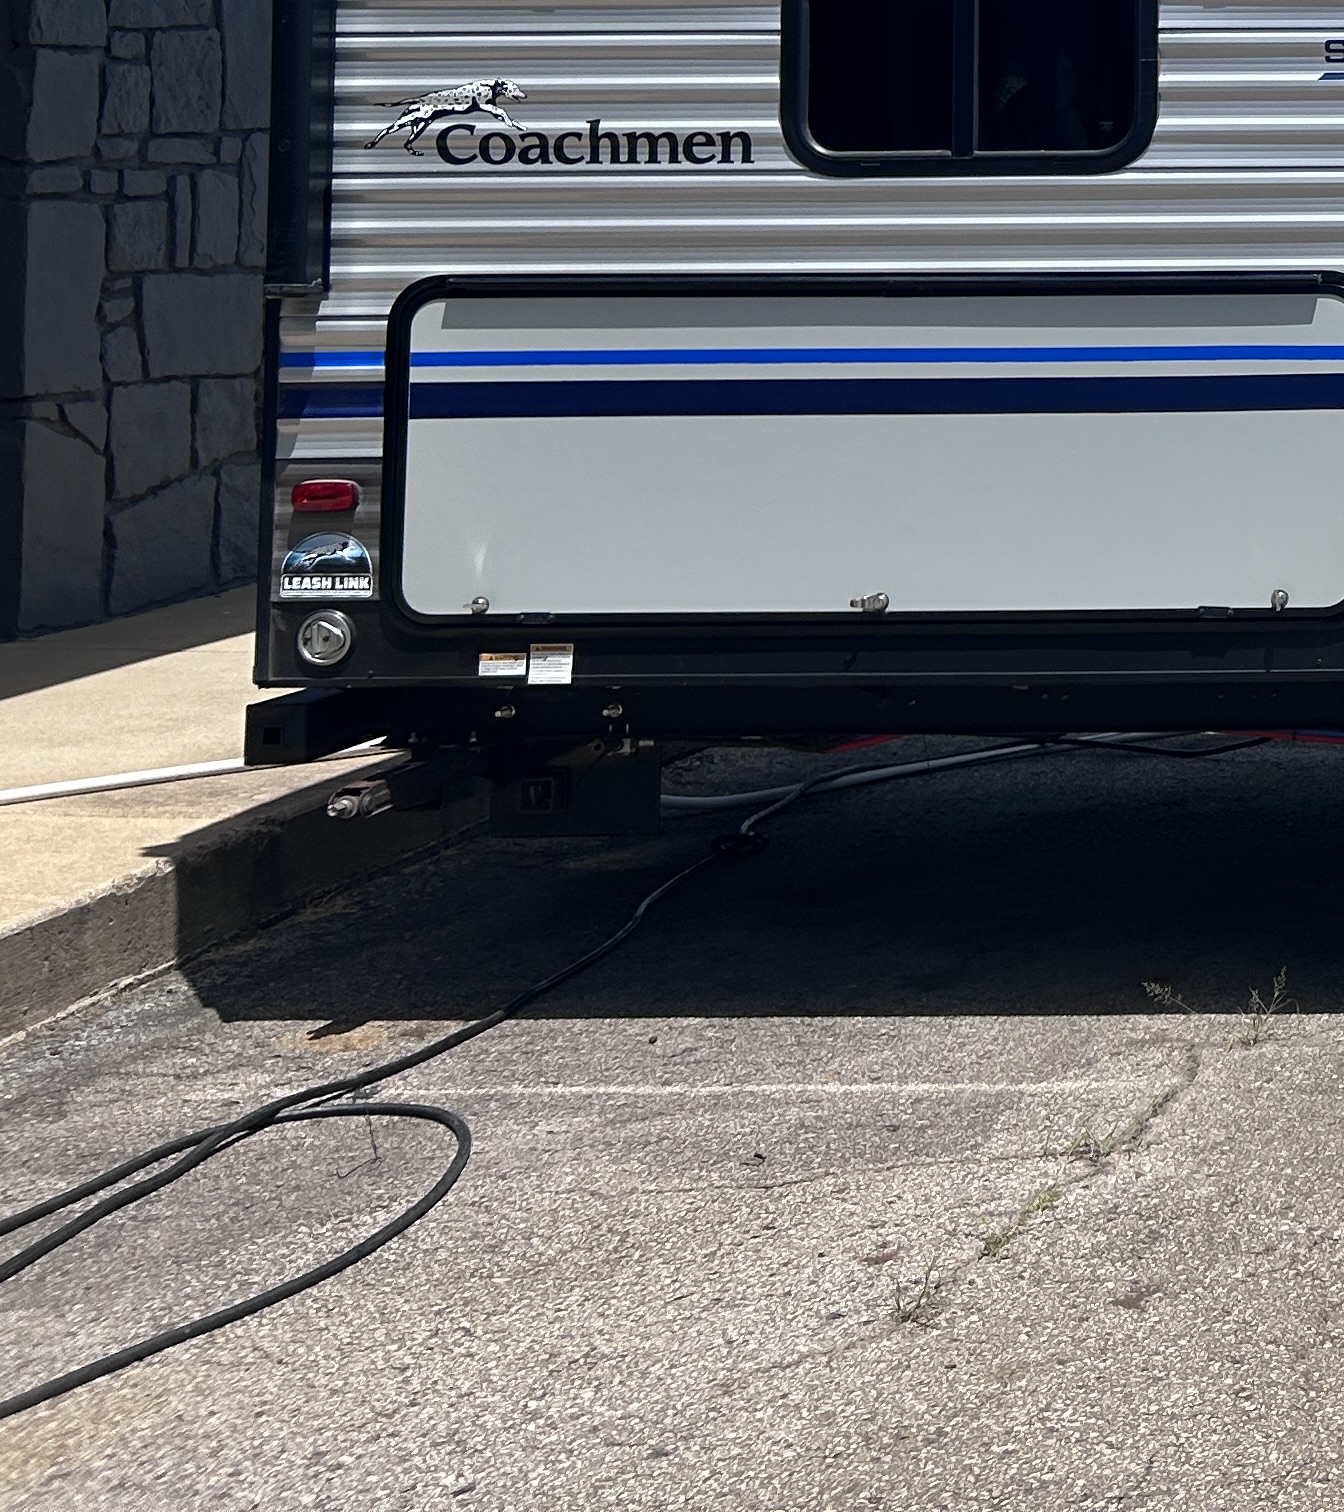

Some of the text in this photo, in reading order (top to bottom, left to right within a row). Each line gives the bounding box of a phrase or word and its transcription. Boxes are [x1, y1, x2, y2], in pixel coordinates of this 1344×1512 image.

[435, 119, 755, 166] Coachmen
[283, 576, 370, 590] LEASH LINK
